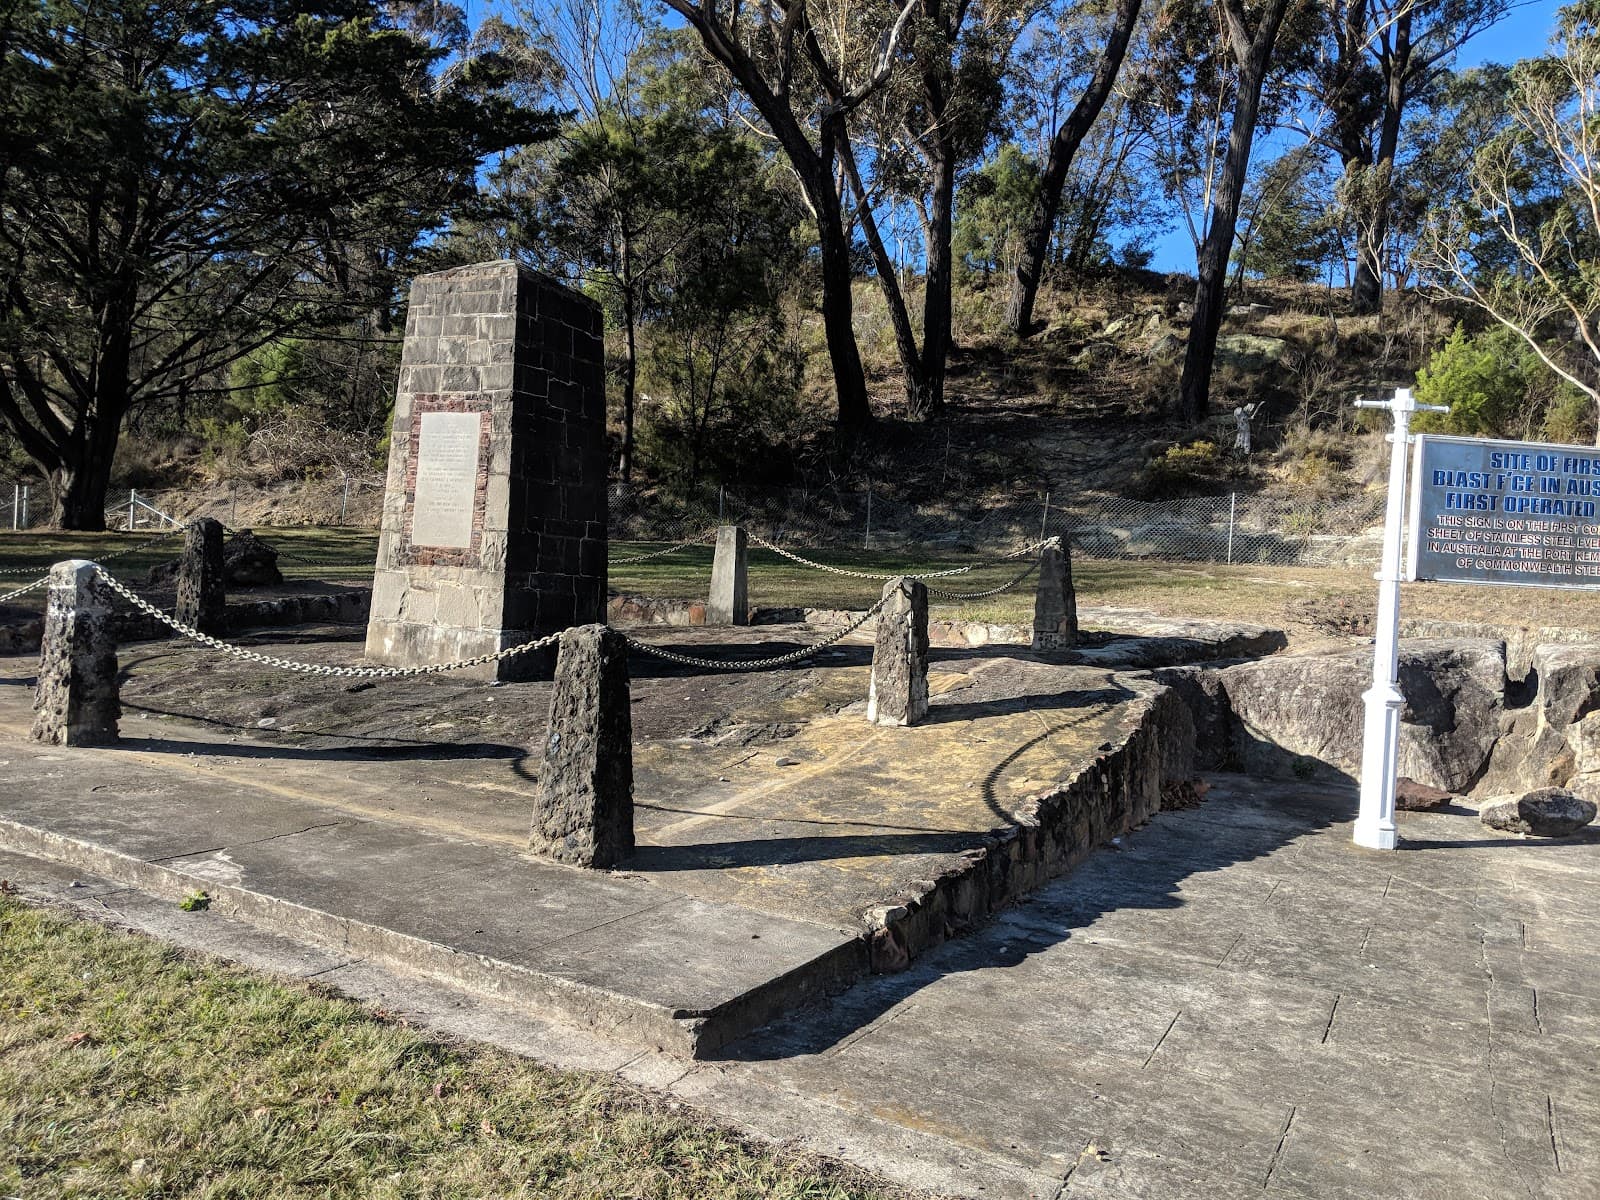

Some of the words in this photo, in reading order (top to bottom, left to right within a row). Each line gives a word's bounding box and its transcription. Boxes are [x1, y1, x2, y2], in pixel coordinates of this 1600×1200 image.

[1490, 452, 1530, 471] SITE
[1536, 455, 1558, 472] OF
[1432, 468, 1491, 490] BLAST
[1540, 476, 1561, 494] IN
[1445, 491, 1498, 511] FIRST
[1503, 495, 1595, 518] OPERATED
[1437, 514, 1463, 526] THIS
[1465, 516, 1491, 529] SIGN
[1494, 518, 1504, 529] IS
[1506, 518, 1524, 531] ON
[1526, 520, 1549, 532] THE
[1551, 521, 1580, 534] FIRST
[1427, 527, 1464, 540] SHEET
[1465, 530, 1482, 541] OF
[1483, 531, 1541, 545] STAINLESS
[1543, 534, 1575, 547] STEEL
[1577, 536, 1600, 549] EVE
[1427, 541, 1439, 552] IN
[1441, 542, 1501, 557] AUSTRALIA
[1503, 546, 1517, 557] AT
[1519, 547, 1542, 559] THE
[1545, 548, 1572, 561] PORT
[1456, 557, 1473, 568] OF
[1475, 558, 1572, 575] COMMONWEALTH
